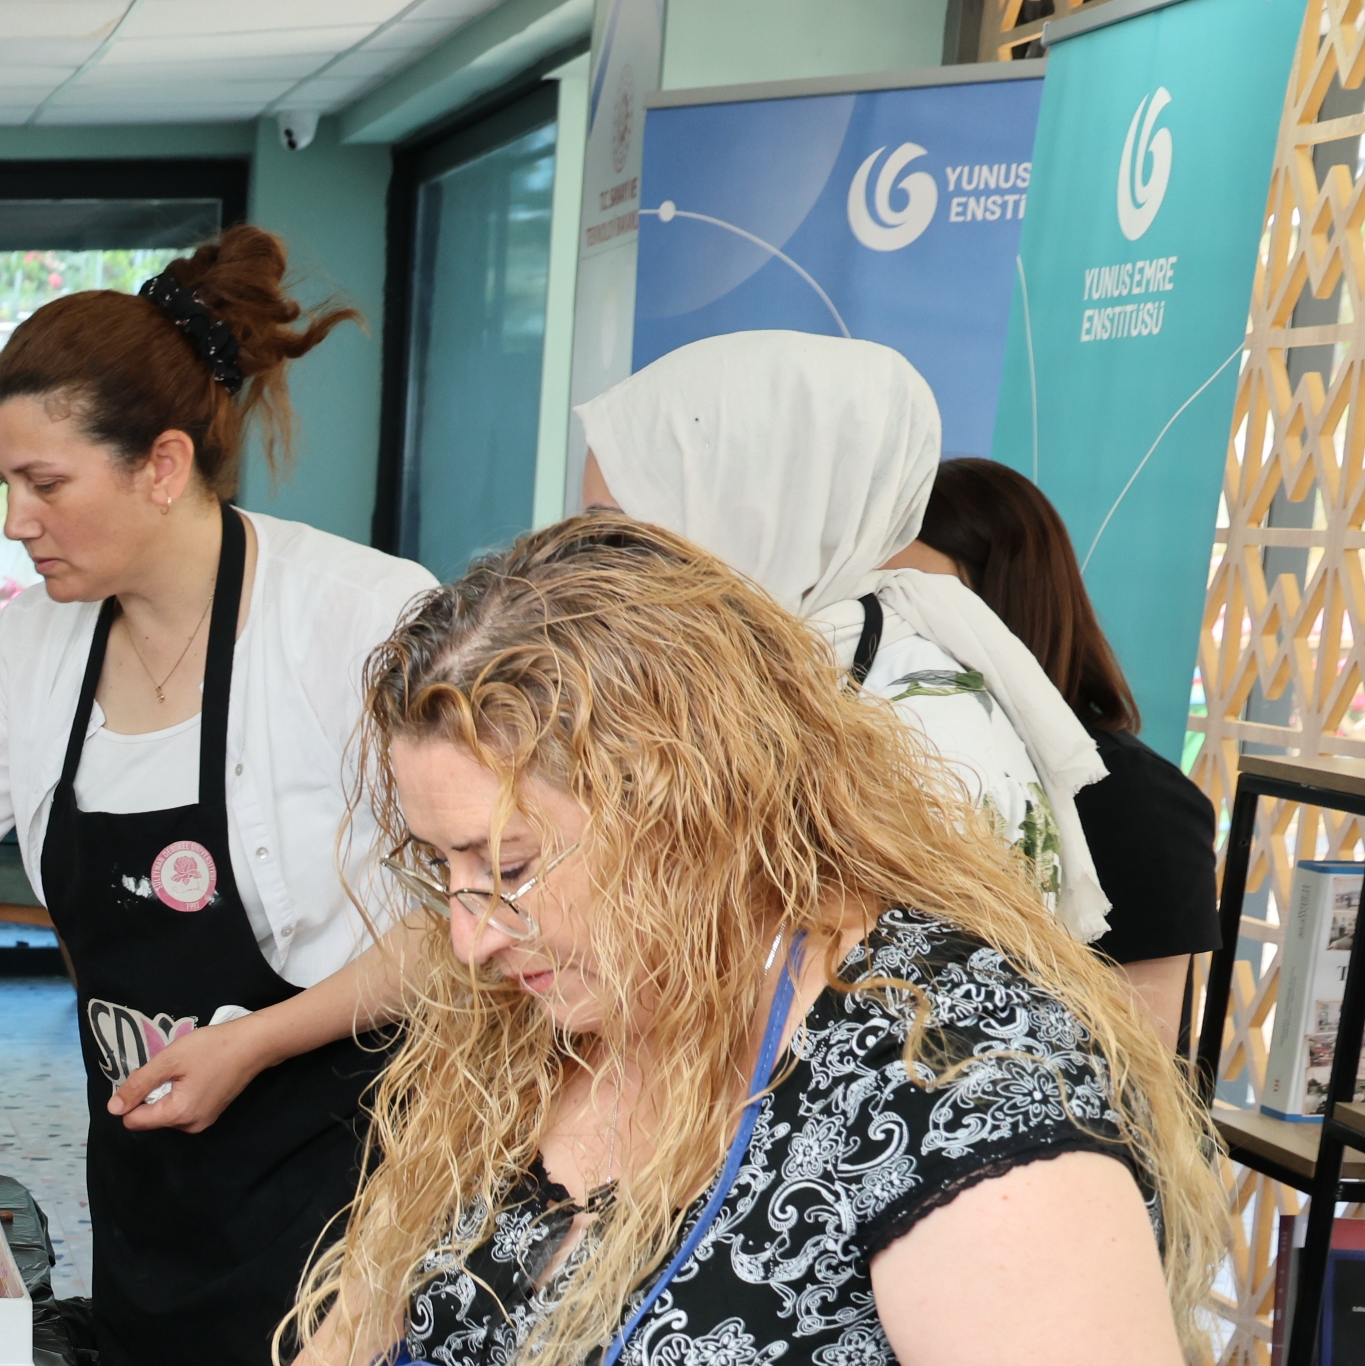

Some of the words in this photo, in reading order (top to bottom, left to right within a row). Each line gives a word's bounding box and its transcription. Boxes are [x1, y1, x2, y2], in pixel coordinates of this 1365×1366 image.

[945, 162, 1032, 192] YUNUS
[1083, 263, 1132, 301] YUNUS
[1132, 256, 1178, 295] EMRE
[1080, 301, 1166, 342] ENSTİTÜSÜ
